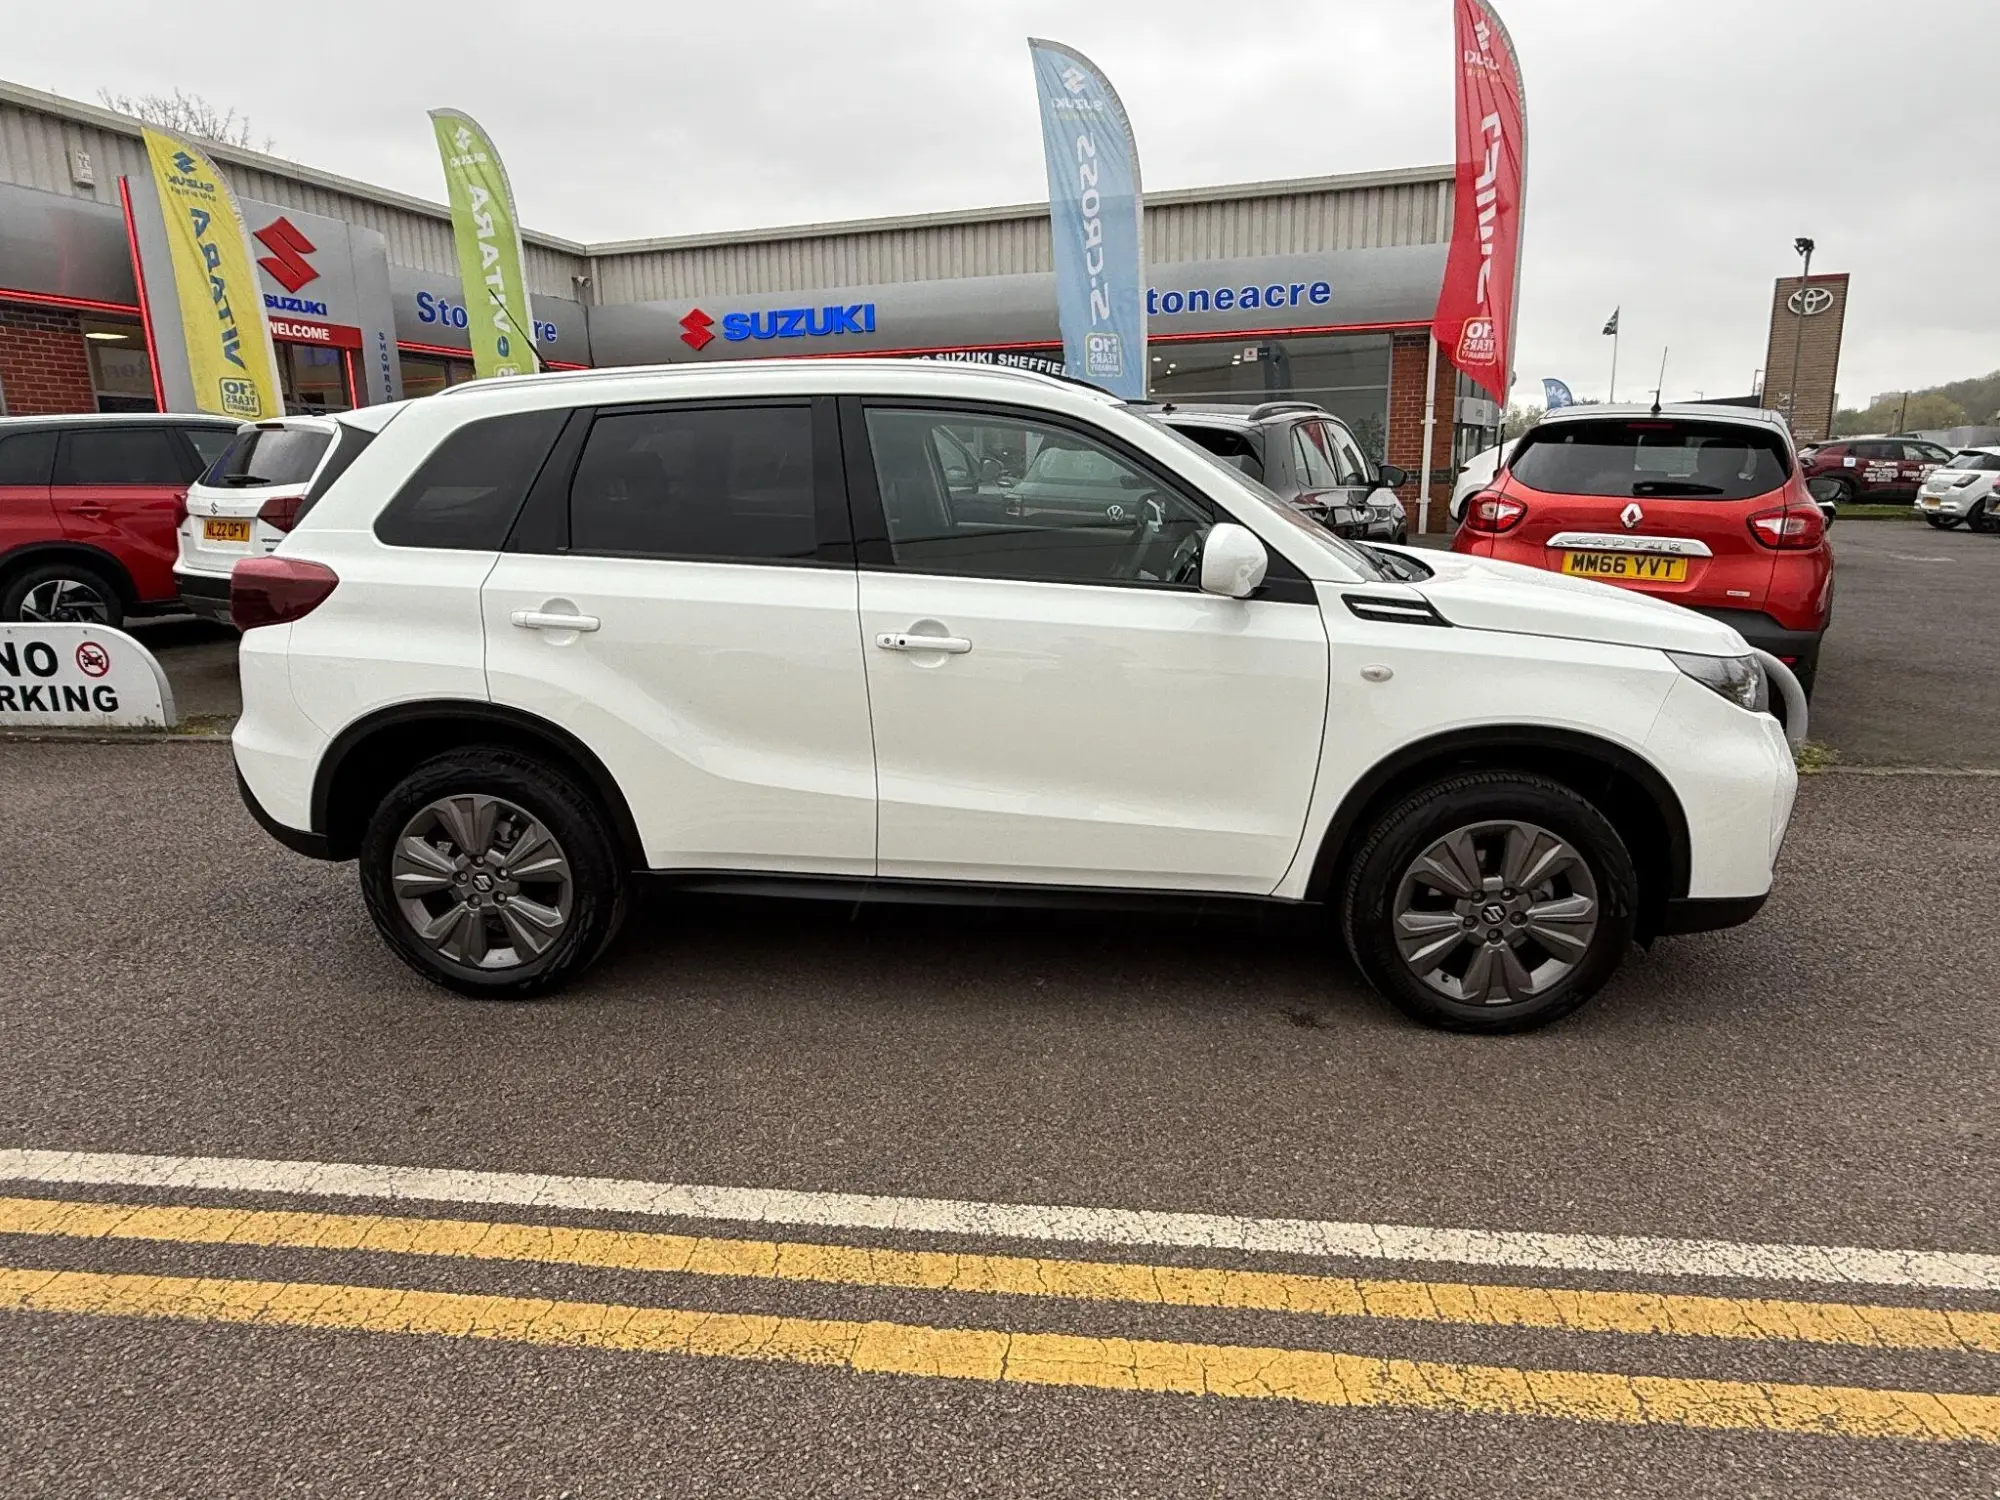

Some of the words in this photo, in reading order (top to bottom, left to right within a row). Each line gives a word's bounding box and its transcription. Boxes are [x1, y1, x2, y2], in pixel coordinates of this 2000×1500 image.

[262, 293, 328, 316] SUZUKI
[1146, 281, 1332, 316] toneacre
[722, 303, 876, 342] SUZUKI
[997, 353, 1070, 377] SHEFFIEL
[206, 520, 227, 537] NL22
[1577, 536, 1681, 551] CAPTUR
[1571, 554, 1626, 574] MM66
[1634, 557, 1676, 577] YVT
[0, 641, 58, 678] NO
